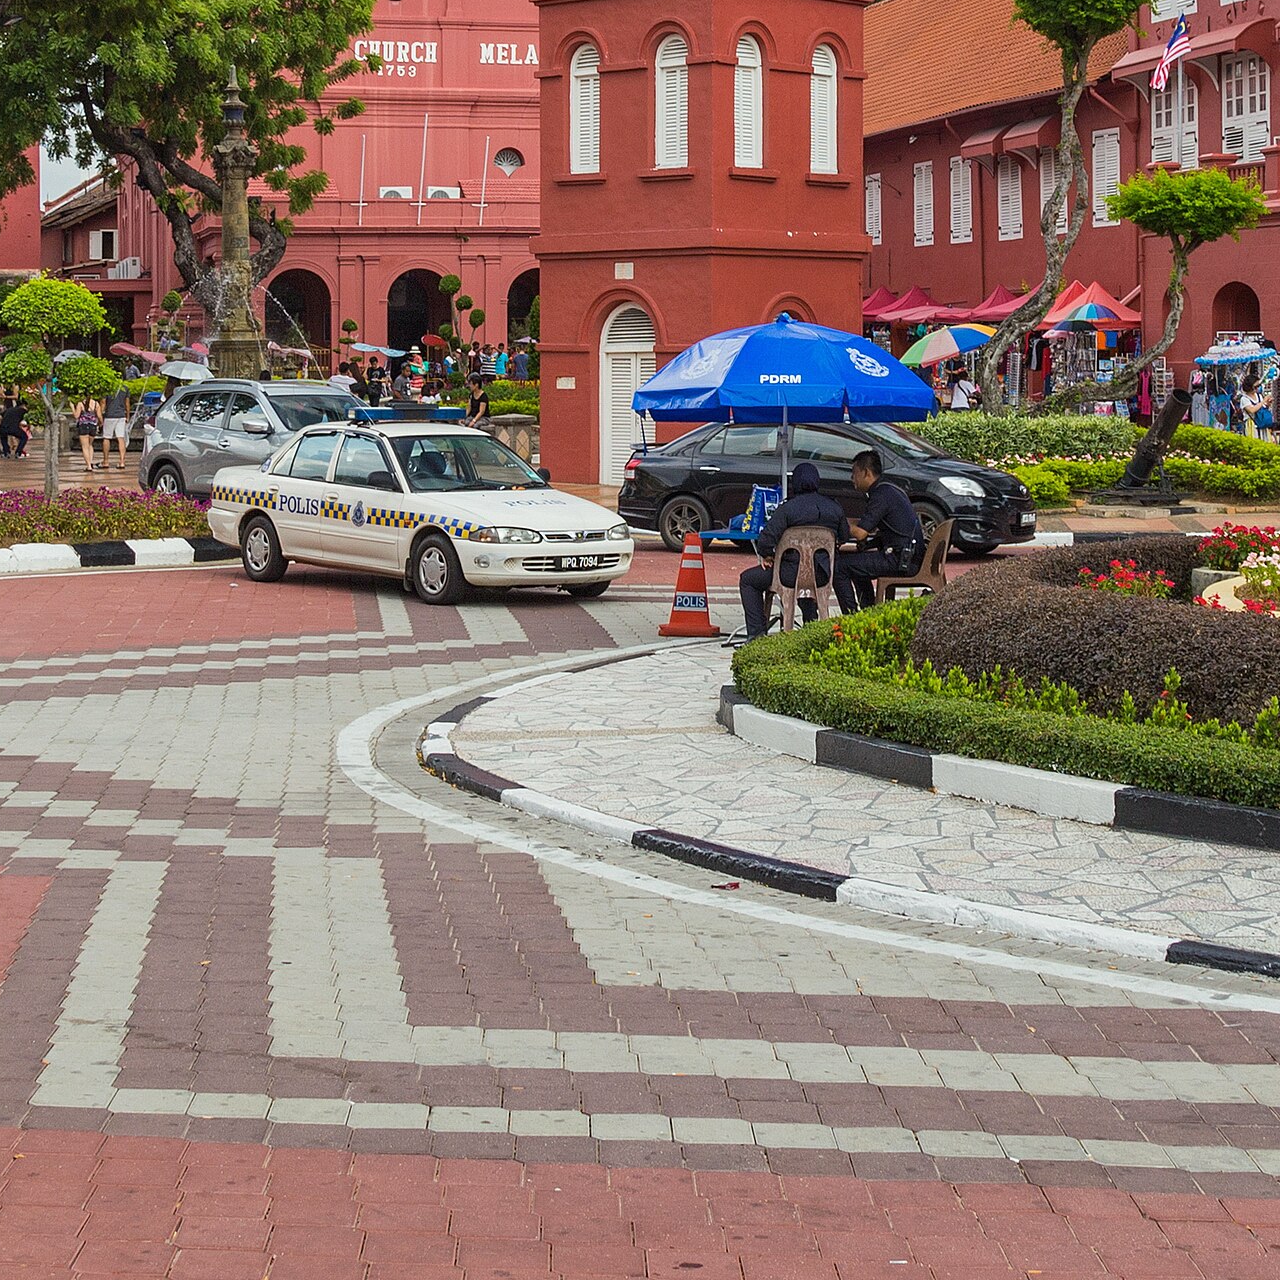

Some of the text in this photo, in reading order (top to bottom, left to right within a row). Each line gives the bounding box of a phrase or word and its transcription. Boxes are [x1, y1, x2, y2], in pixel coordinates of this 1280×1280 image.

[354, 40, 438, 64] CHURCH
[377, 65, 417, 77] 1753
[759, 374, 802, 384] PDRM
[279, 494, 319, 517] POLIS
[579, 556, 598, 568] 7094
[676, 596, 705, 607] POLIS
